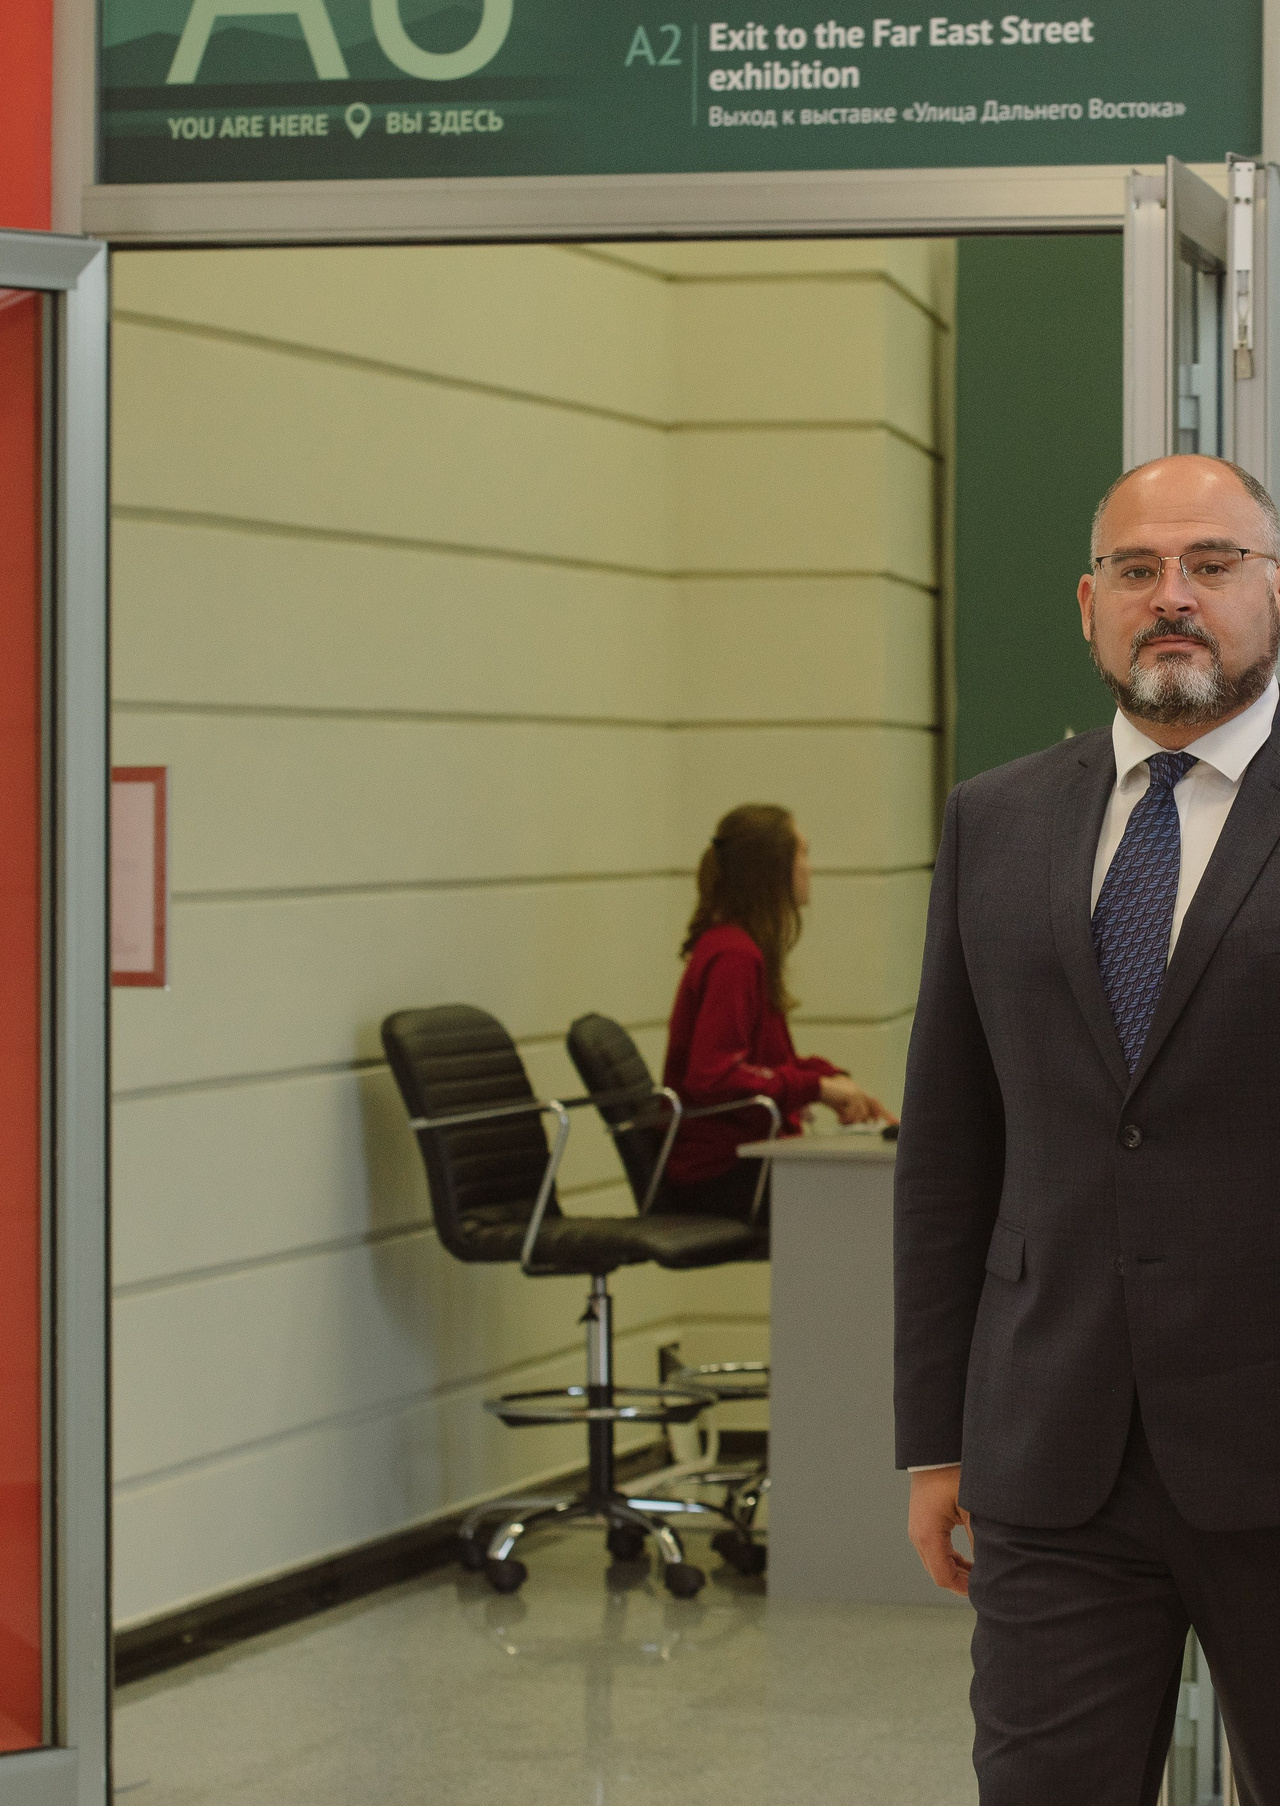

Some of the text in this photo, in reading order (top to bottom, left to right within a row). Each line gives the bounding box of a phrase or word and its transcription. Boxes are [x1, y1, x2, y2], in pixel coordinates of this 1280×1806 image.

[624, 23, 682, 67] A2
[709, 15, 1094, 52] Exit to the Far East Street
[708, 60, 860, 92] exhibition
[167, 112, 329, 140] YOU ARE HERE
[386, 108, 504, 135] ВЫ ЗДЕСЬ
[708, 97, 1188, 128] Выход к выставке «Улица Дальнего Востока»
